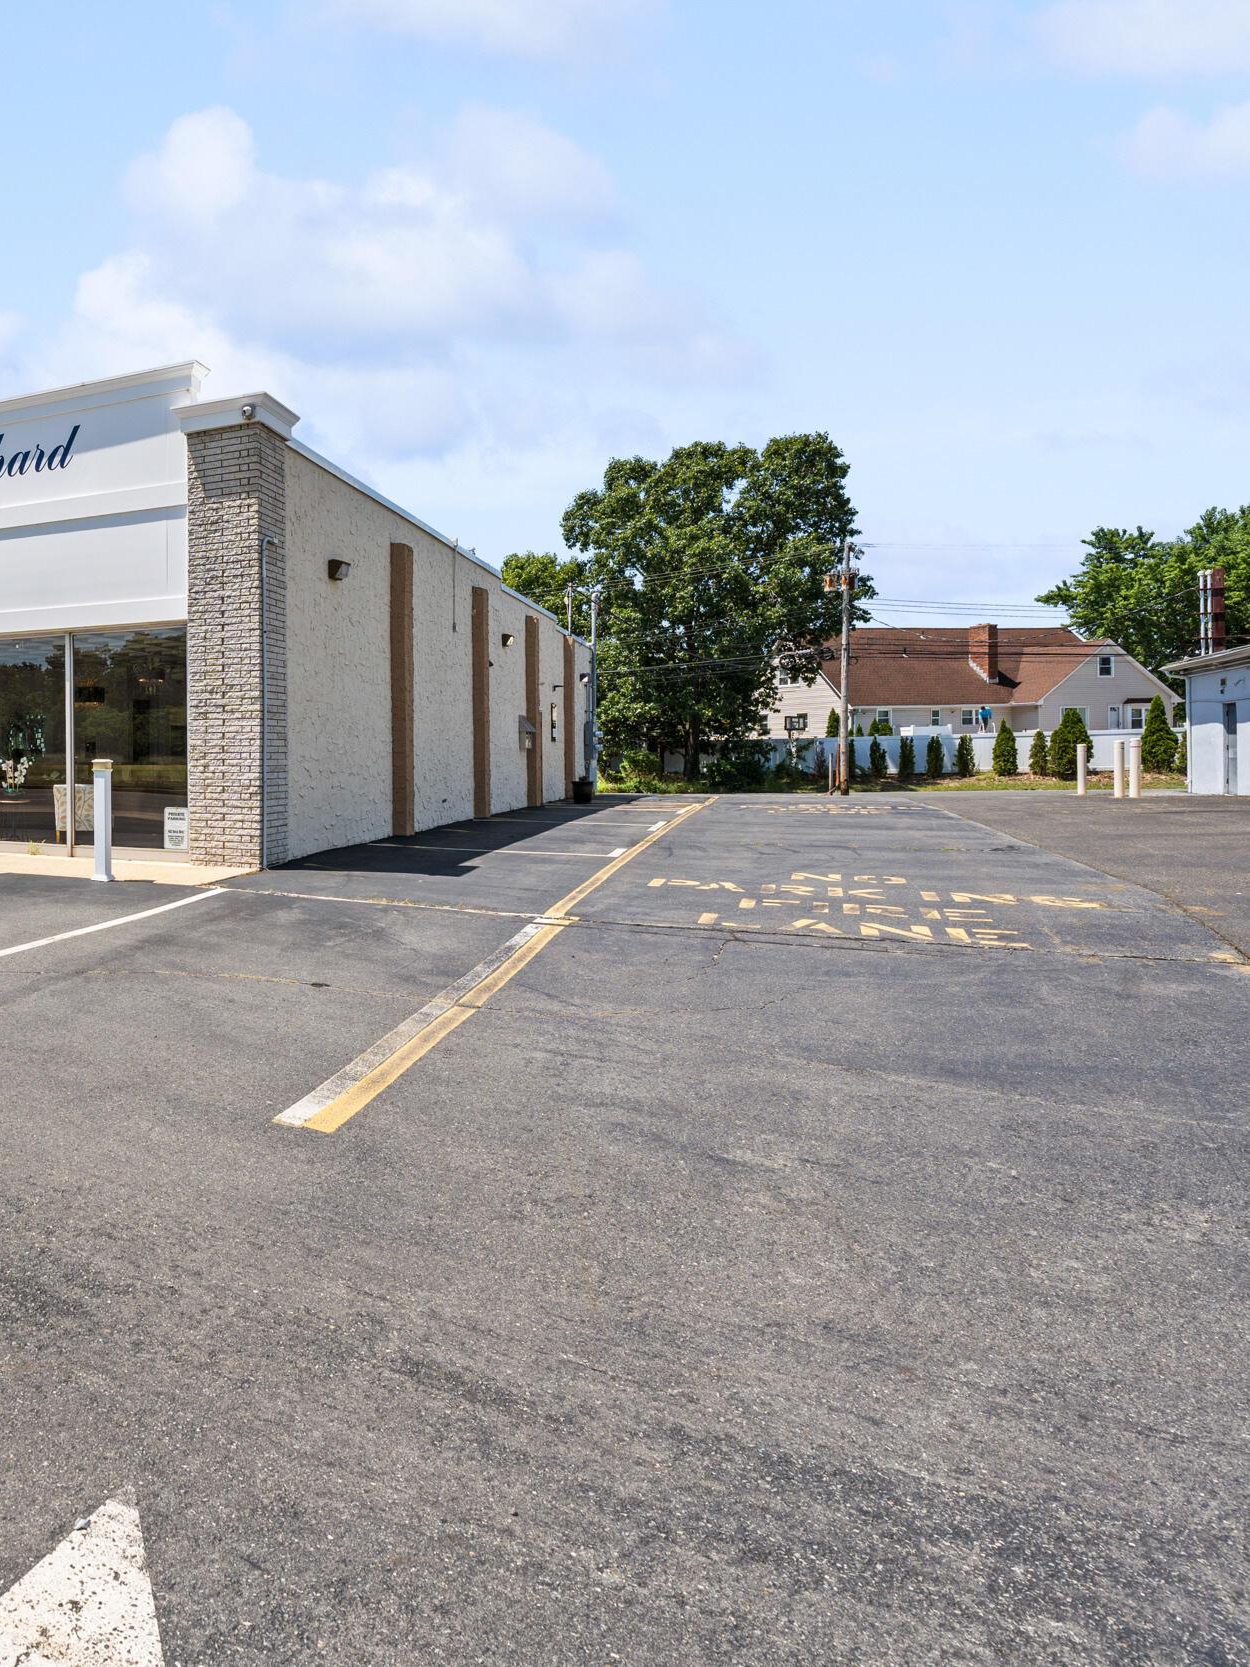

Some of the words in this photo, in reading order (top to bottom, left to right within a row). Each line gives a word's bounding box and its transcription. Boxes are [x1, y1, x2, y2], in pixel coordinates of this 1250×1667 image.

[791, 872, 907, 885] NO
[647, 878, 1112, 908] PARKING
[739, 898, 993, 922] FIRE
[697, 912, 1035, 950] LANE
